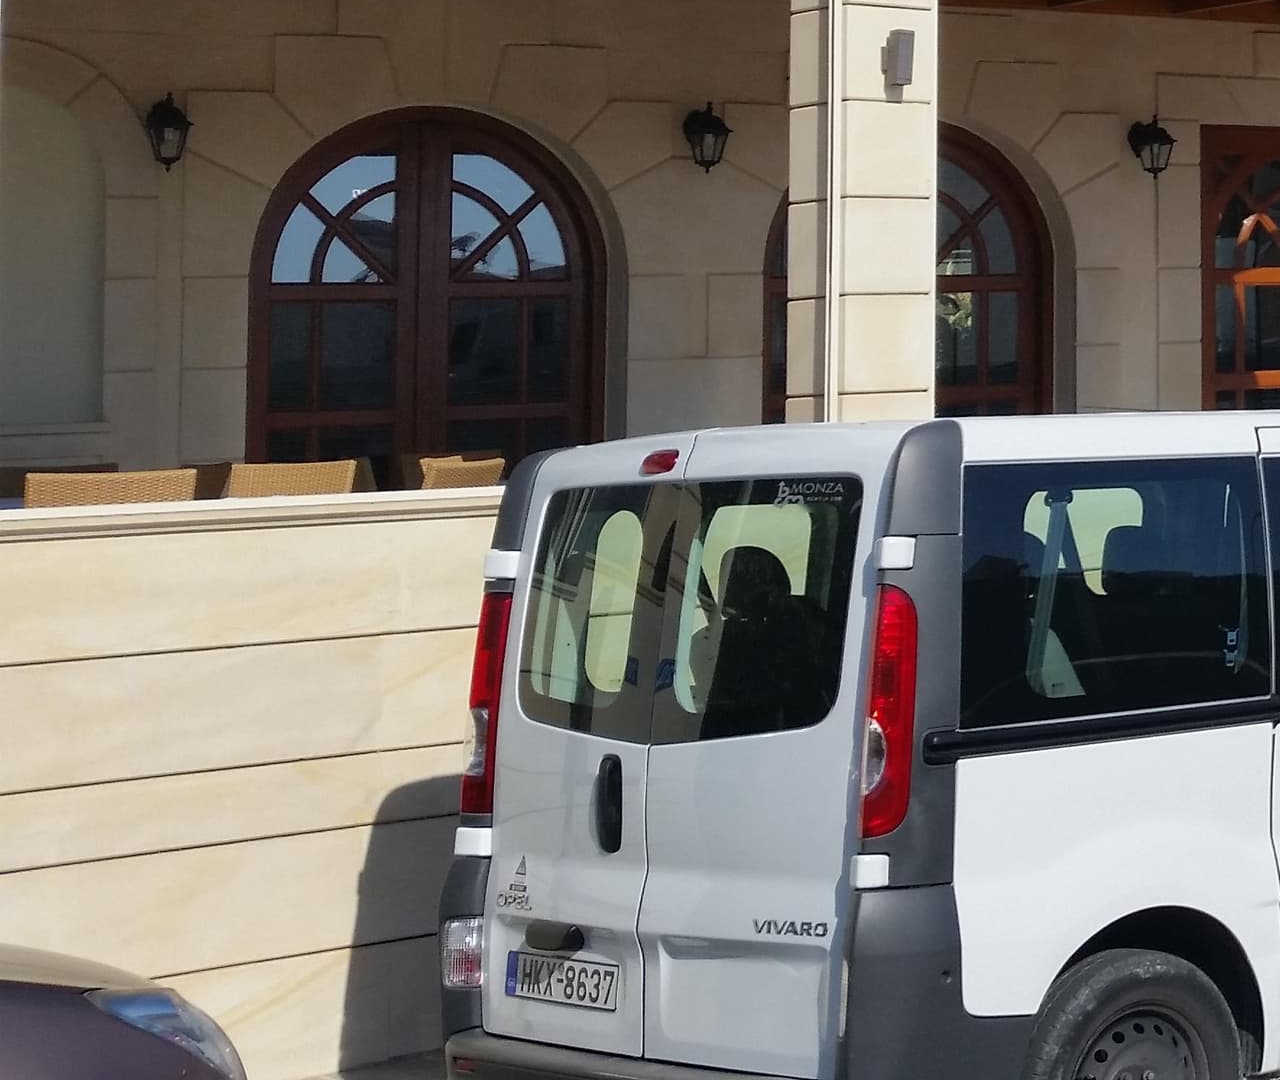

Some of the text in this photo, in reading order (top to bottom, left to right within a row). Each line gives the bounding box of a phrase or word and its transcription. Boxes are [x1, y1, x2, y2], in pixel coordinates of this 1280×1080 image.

[790, 482, 844, 494] MONZA
[497, 893, 533, 911] OPEL
[752, 919, 829, 937] VIVARO
